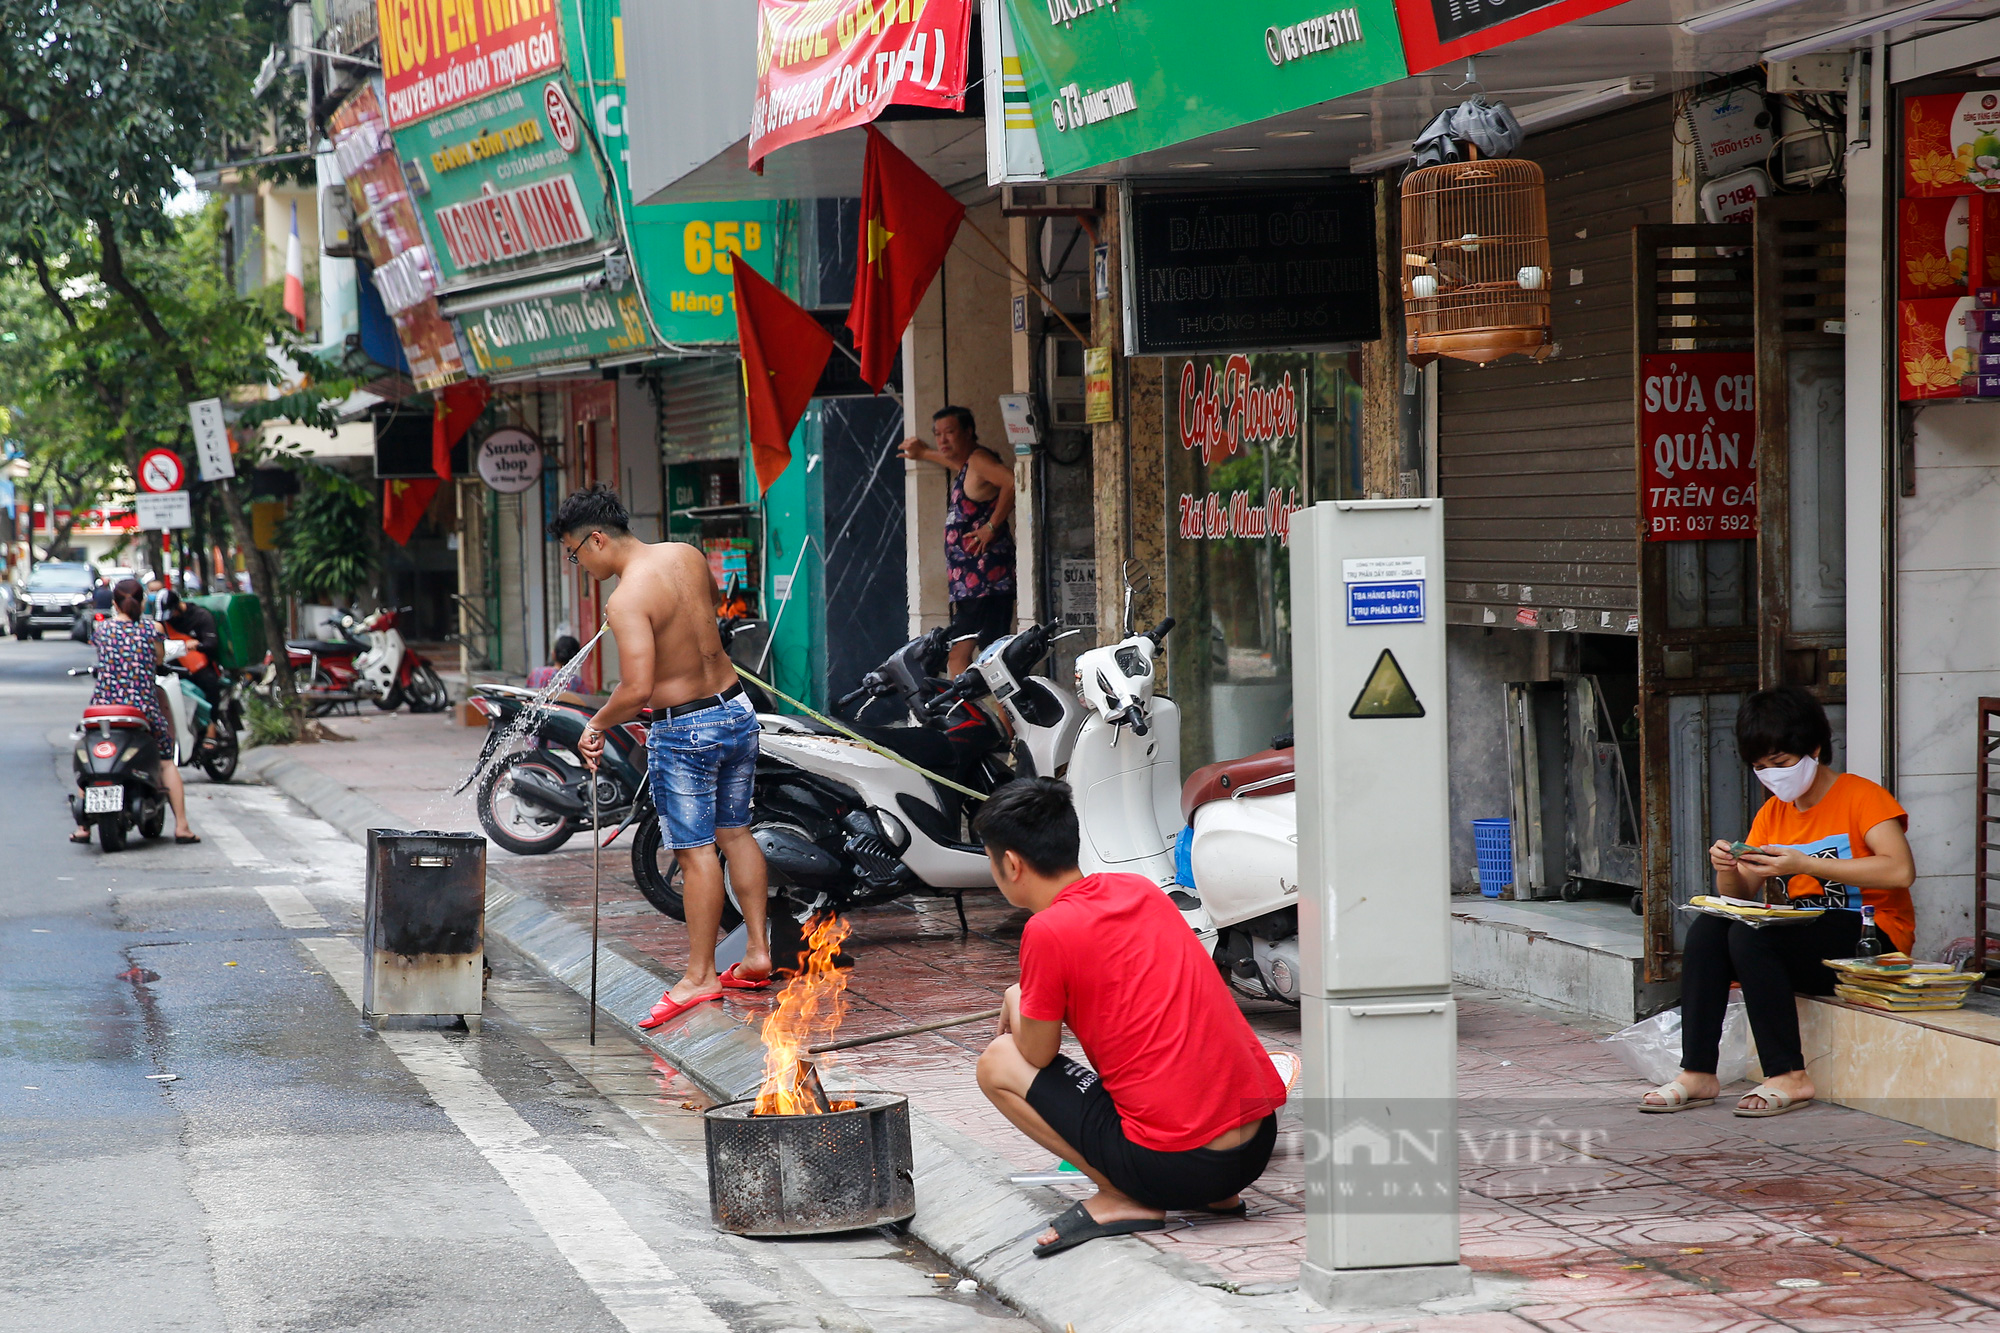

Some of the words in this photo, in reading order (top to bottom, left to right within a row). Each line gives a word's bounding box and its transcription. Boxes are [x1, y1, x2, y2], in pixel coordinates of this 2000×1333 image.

[389, 71, 436, 123] CHUYÊN
[435, 57, 466, 105] CƯỚI
[465, 44, 490, 92] HỎI
[490, 40, 527, 85] TRỌN
[528, 21, 556, 69] GÓI
[1060, 82, 1086, 129] 73
[431, 143, 475, 174] BÁNH
[469, 127, 506, 161] CỐM
[504, 118, 544, 151] TƯƠI
[1712, 133, 1763, 157] 19001515
[1716, 184, 1756, 211] P198
[436, 181, 527, 269] NGUYÊN
[515, 175, 587, 252] NINH
[516, 299, 551, 342] Hỏi
[581, 291, 616, 331] Gói
[670, 291, 724, 316] Hàng
[1179, 360, 1222, 467] Café
[1223, 353, 1298, 455] Flower
[1645, 363, 1707, 413] SỬA
[1714, 375, 1755, 412] CH
[201, 406, 224, 475] SUZUKA
[485, 439, 536, 458] Suzuka
[1654, 416, 1740, 479] QUẦN
[495, 457, 528, 474] shop
[1205, 491, 1228, 539] Cho
[1230, 488, 1266, 538] Nhau
[1650, 482, 1714, 508] TRÊN
[1722, 482, 1756, 507] GÁ
[1652, 516, 1681, 532] ĐT:
[1686, 515, 1714, 531] 037
[1720, 515, 1750, 531] 592
[1353, 592, 1367, 601] TBA
[1367, 590, 1386, 600] HÀNG
[1353, 606, 1369, 616] TRỤ
[1370, 604, 1391, 615] PHÂN
[1392, 604, 1408, 614] DÂY
